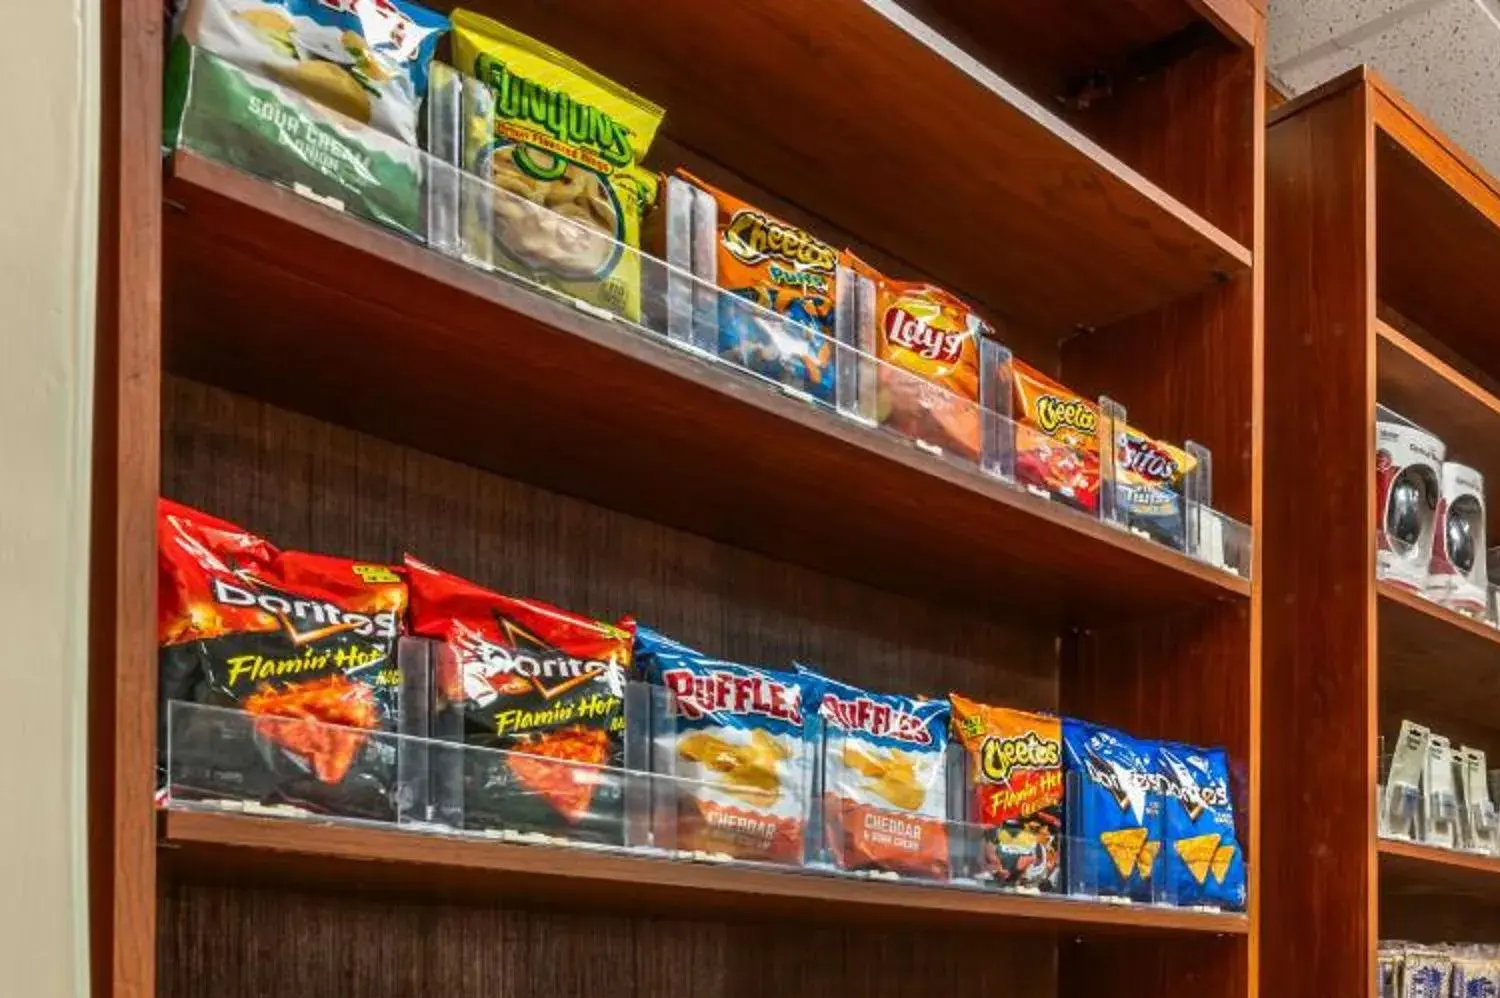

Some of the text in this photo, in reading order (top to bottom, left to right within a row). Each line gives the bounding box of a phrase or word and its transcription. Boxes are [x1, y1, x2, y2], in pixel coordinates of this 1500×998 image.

[213, 578, 398, 638] Doritos
[333, 644, 384, 669] Hot
[577, 692, 621, 719] Hot
[664, 668, 803, 724] RUFFLES
[863, 813, 922, 841] CHEDDAR
